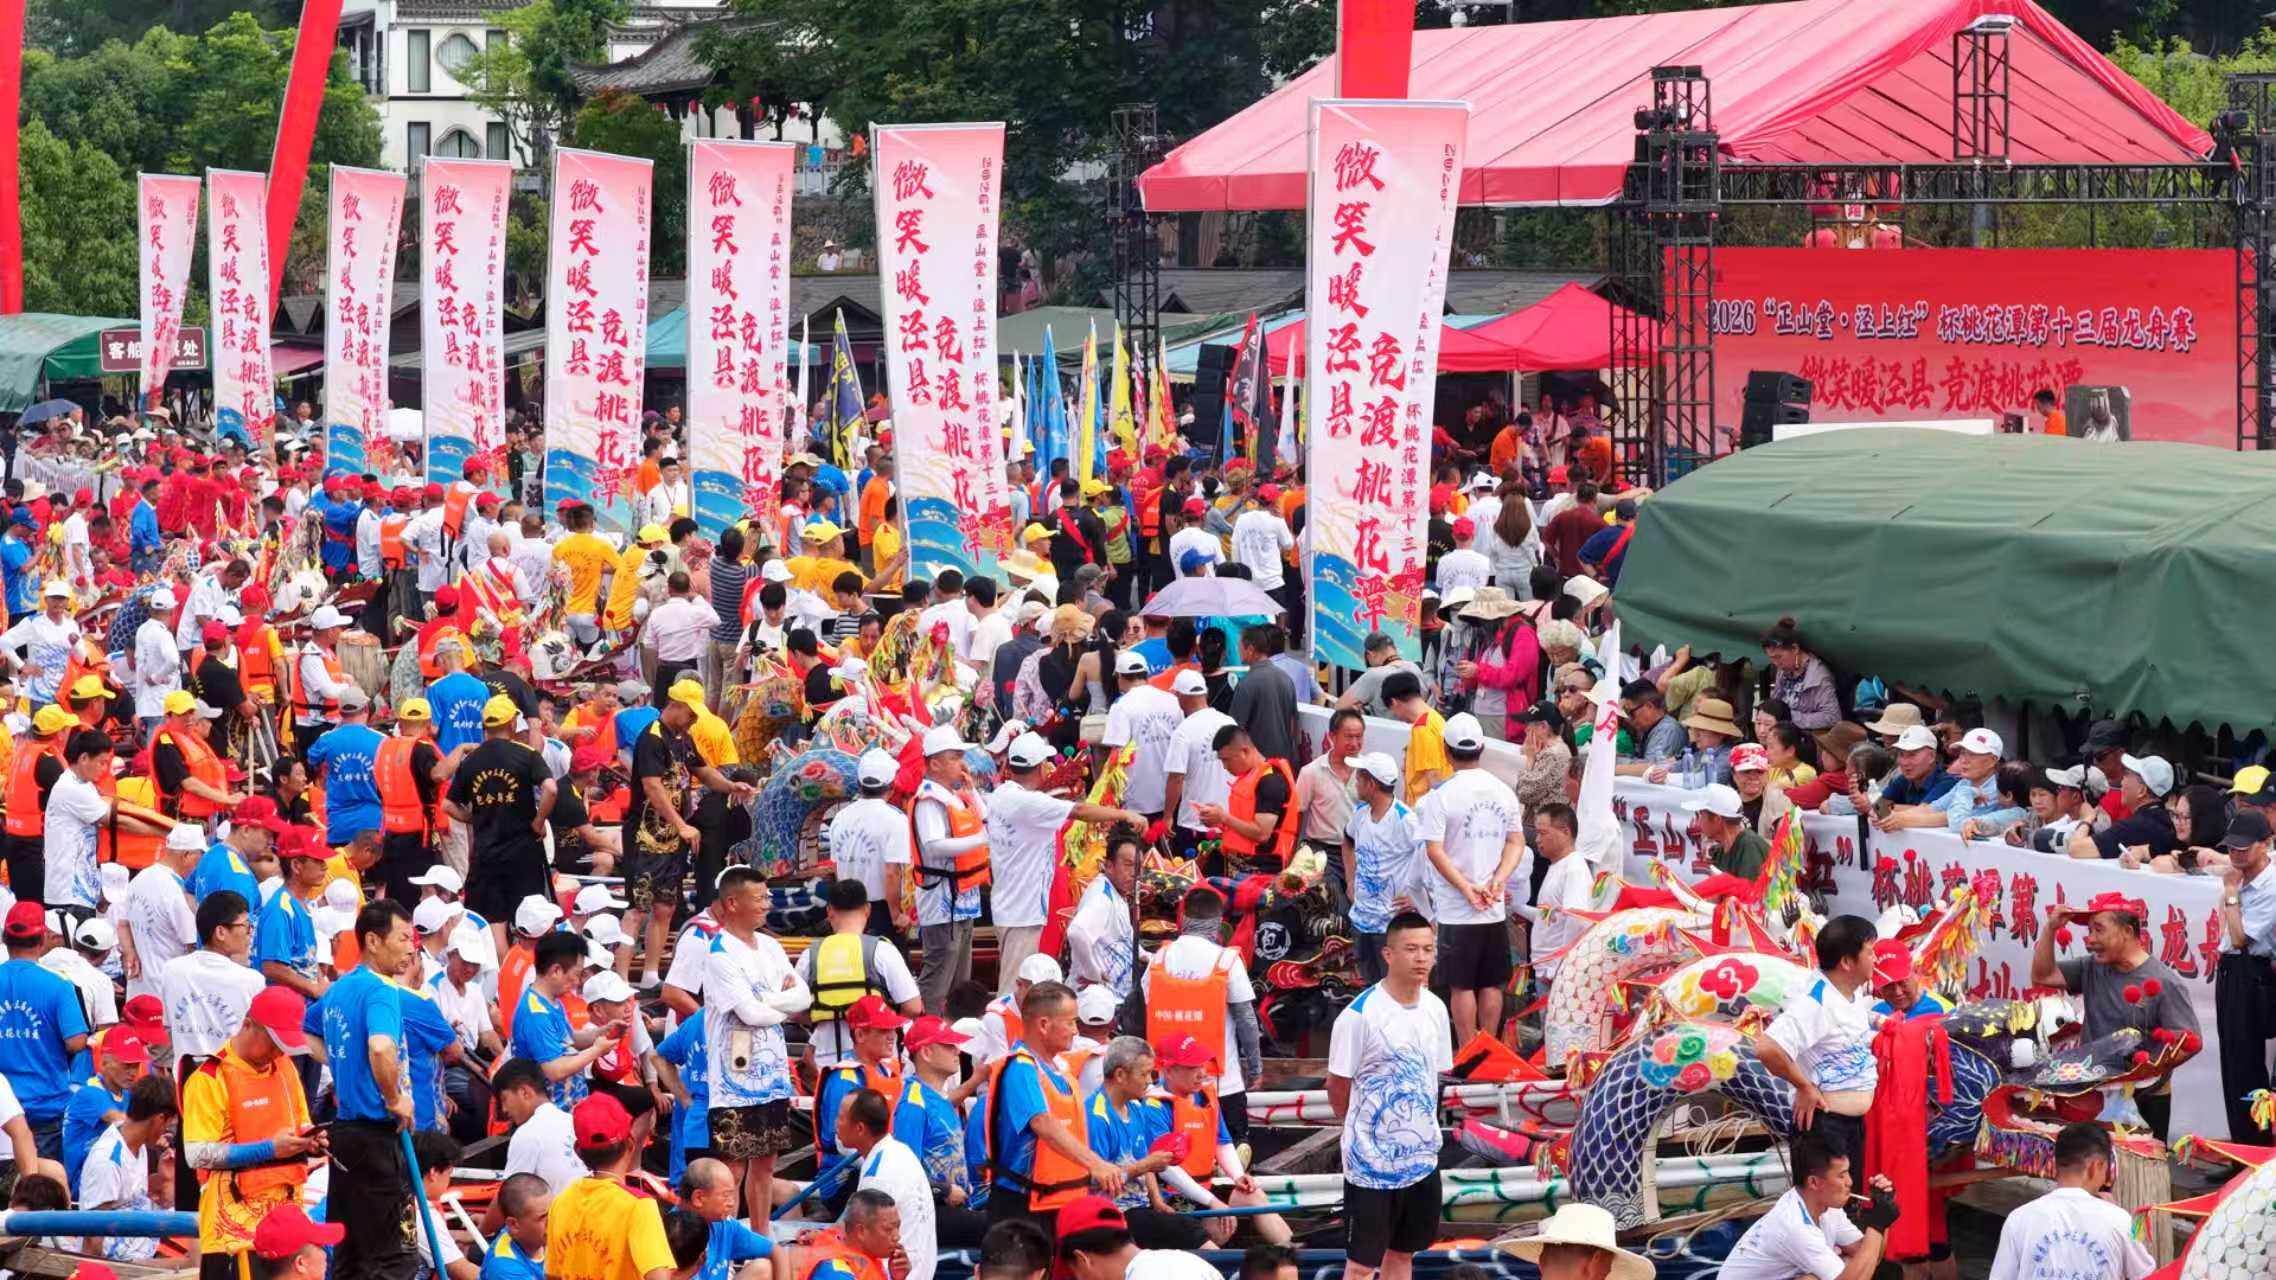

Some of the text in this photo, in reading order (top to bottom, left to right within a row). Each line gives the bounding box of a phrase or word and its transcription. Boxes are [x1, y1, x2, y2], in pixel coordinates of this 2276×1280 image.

[434, 184, 463, 365] 微笑暖泾县
[567, 179, 604, 375] 微笑暖泾县
[708, 171, 742, 389] 微笑暖泾县
[894, 160, 934, 407] 微笑暖泾县
[1325, 143, 1385, 438] 微笑暖泾县
[591, 308, 630, 508] 竞渡桃花潭
[932, 317, 981, 566] 竞渡桃花潭
[1353, 332, 1405, 632] 竞渡桃花潭
